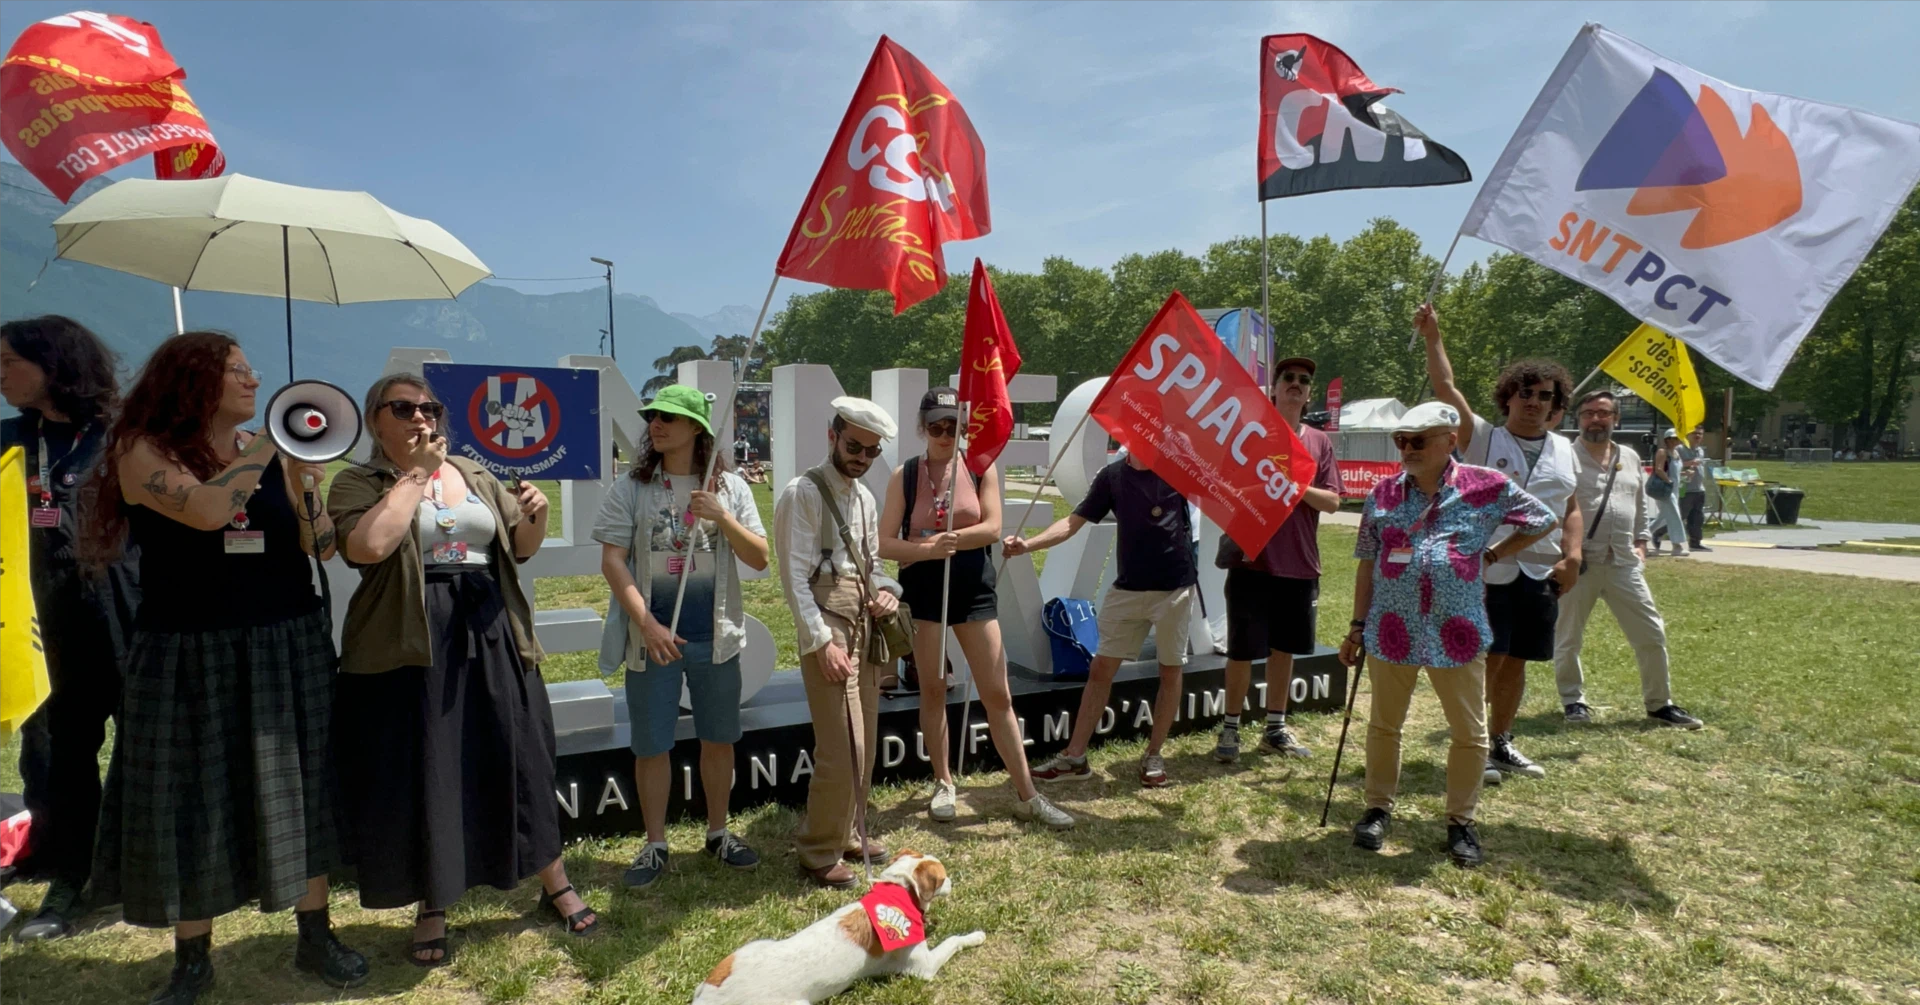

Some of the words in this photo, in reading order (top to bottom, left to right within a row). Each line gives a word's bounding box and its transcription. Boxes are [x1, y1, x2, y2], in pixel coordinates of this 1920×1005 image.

[1548, 211, 1733, 325] SNTPCT
[1647, 338, 1676, 368] des
[1132, 333, 1268, 467] SPIAC
[461, 444, 568, 477] #TOUCHPASMAVF
[1121, 392, 1150, 420] Syndicat
[1149, 416, 1162, 430] des
[1236, 490, 1267, 526] Industries
[1132, 423, 1143, 433] de
[1189, 470, 1197, 478] et
[1196, 474, 1208, 487] du
[1209, 484, 1236, 513] Cinéma
[1256, 458, 1301, 507] cgt
[969, 711, 1070, 755] FLM
[1095, 673, 1330, 734] D'AIMTON
